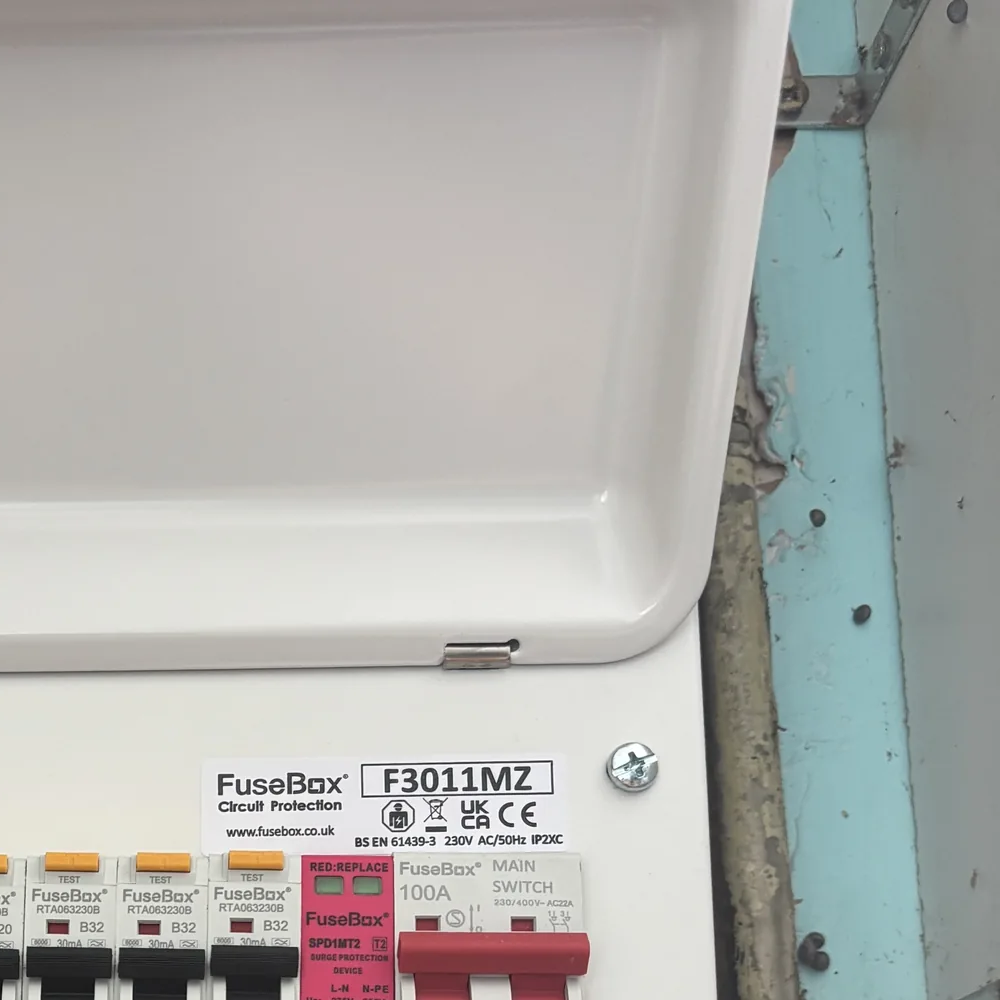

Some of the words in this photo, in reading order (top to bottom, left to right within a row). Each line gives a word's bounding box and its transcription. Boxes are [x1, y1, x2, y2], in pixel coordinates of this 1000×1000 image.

[384, 766, 532, 793] F3011MZ
[218, 800, 264, 812] Circuit
[271, 800, 342, 812] Protection
[226, 825, 335, 838] www.fusebox.co.uk
[355, 837, 370, 847] BS
[373, 837, 388, 847] EN
[391, 836, 436, 847] 61439-3
[445, 835, 473, 846] 230V
[478, 835, 526, 846] AC/50Hz
[532, 834, 563, 845] IP2XC
[310, 862, 388, 872] RED:REPLACE
[493, 860, 536, 872] MAIN
[58, 876, 80, 884] TEST
[150, 876, 172, 884] TEST
[241, 874, 263, 882] TEST
[400, 884, 451, 901] 100A
[493, 881, 553, 894] SWITCH
[37, 905, 100, 914] RTA063230B
[128, 905, 192, 915] RTA063230B
[219, 903, 284, 913] RTA063230B
[80, 922, 104, 932] B32
[172, 923, 196, 933] B32
[263, 921, 288, 931] B32
[331, 984, 349, 992] L-N
[363, 985, 389, 993] N-PE
